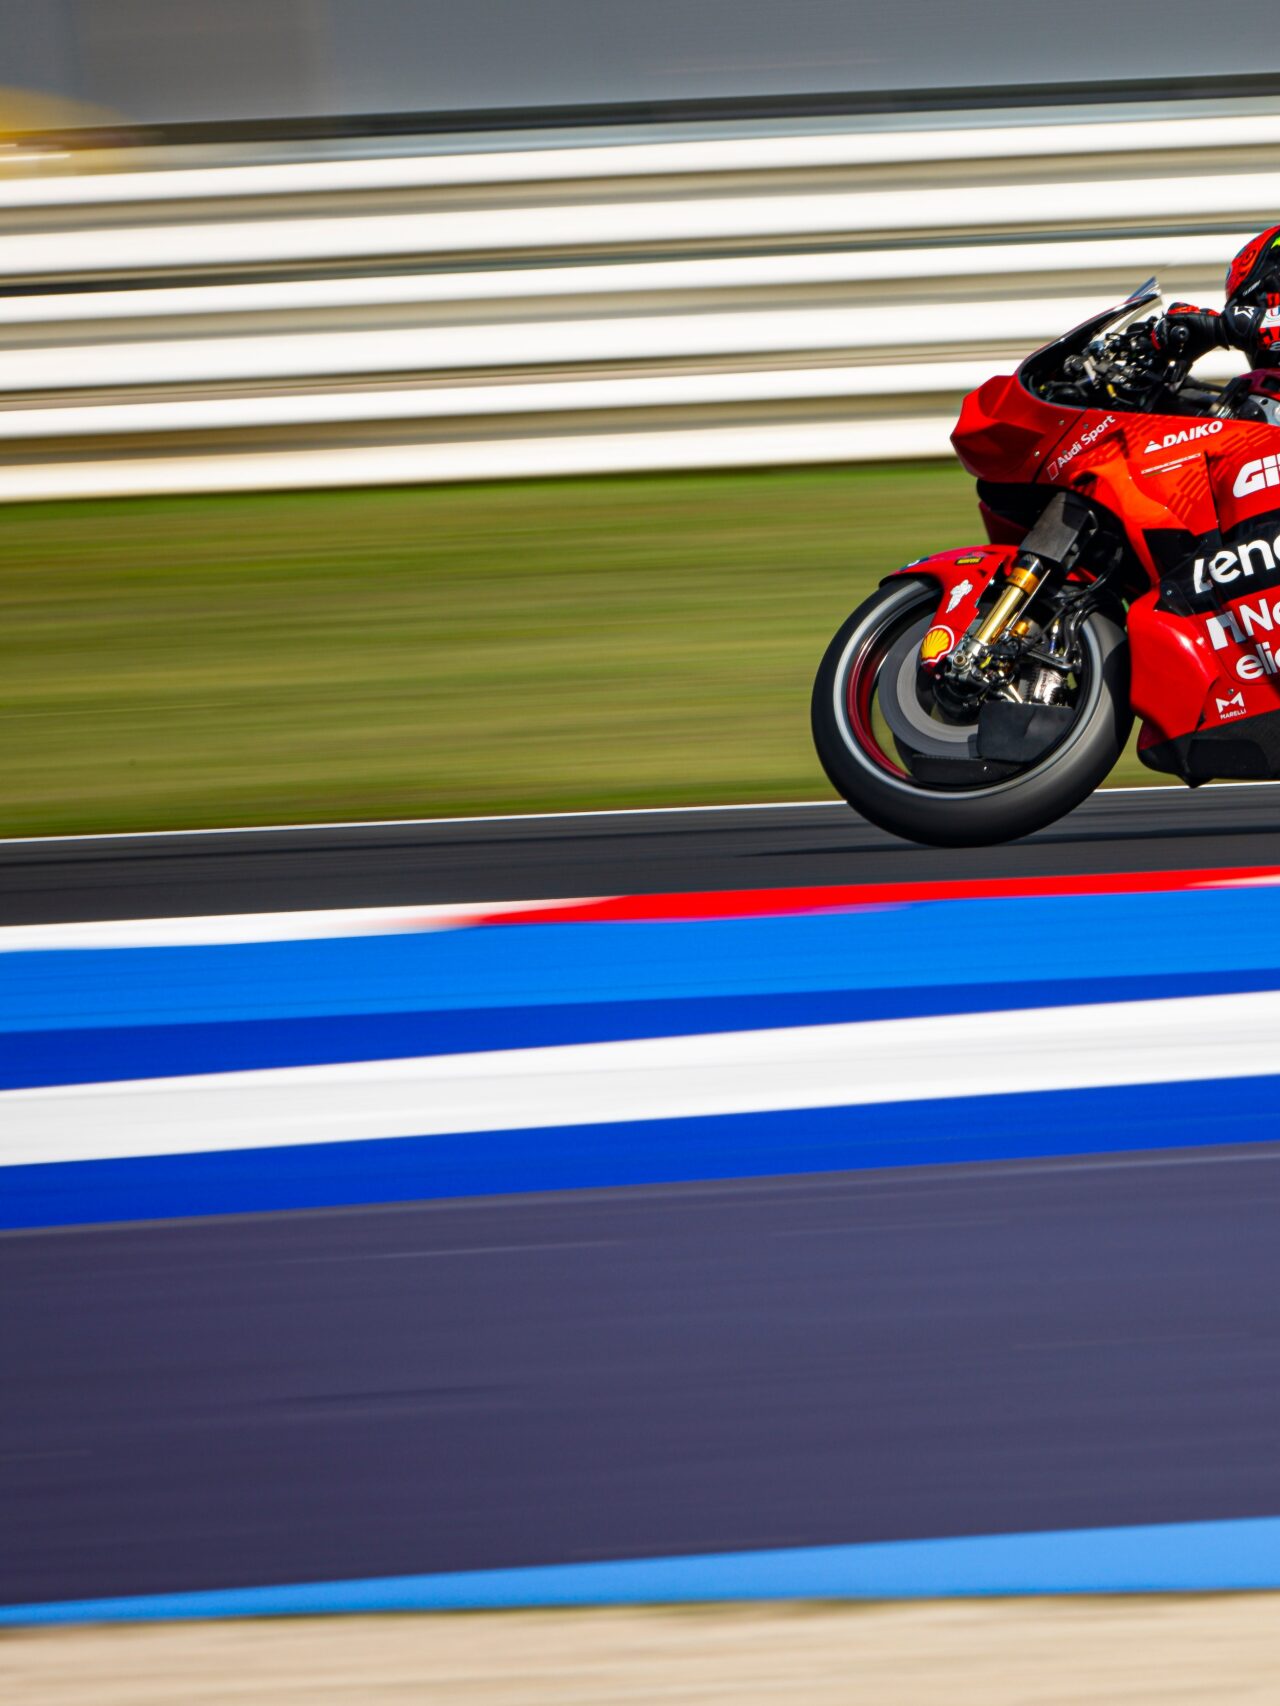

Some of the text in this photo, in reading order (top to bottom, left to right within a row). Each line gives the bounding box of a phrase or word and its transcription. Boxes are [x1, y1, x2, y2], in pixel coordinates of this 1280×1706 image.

[1057, 414, 1116, 467] Audi Sport
[1162, 420, 1223, 448] DAIKO
[1220, 708, 1247, 720] MARELLI
